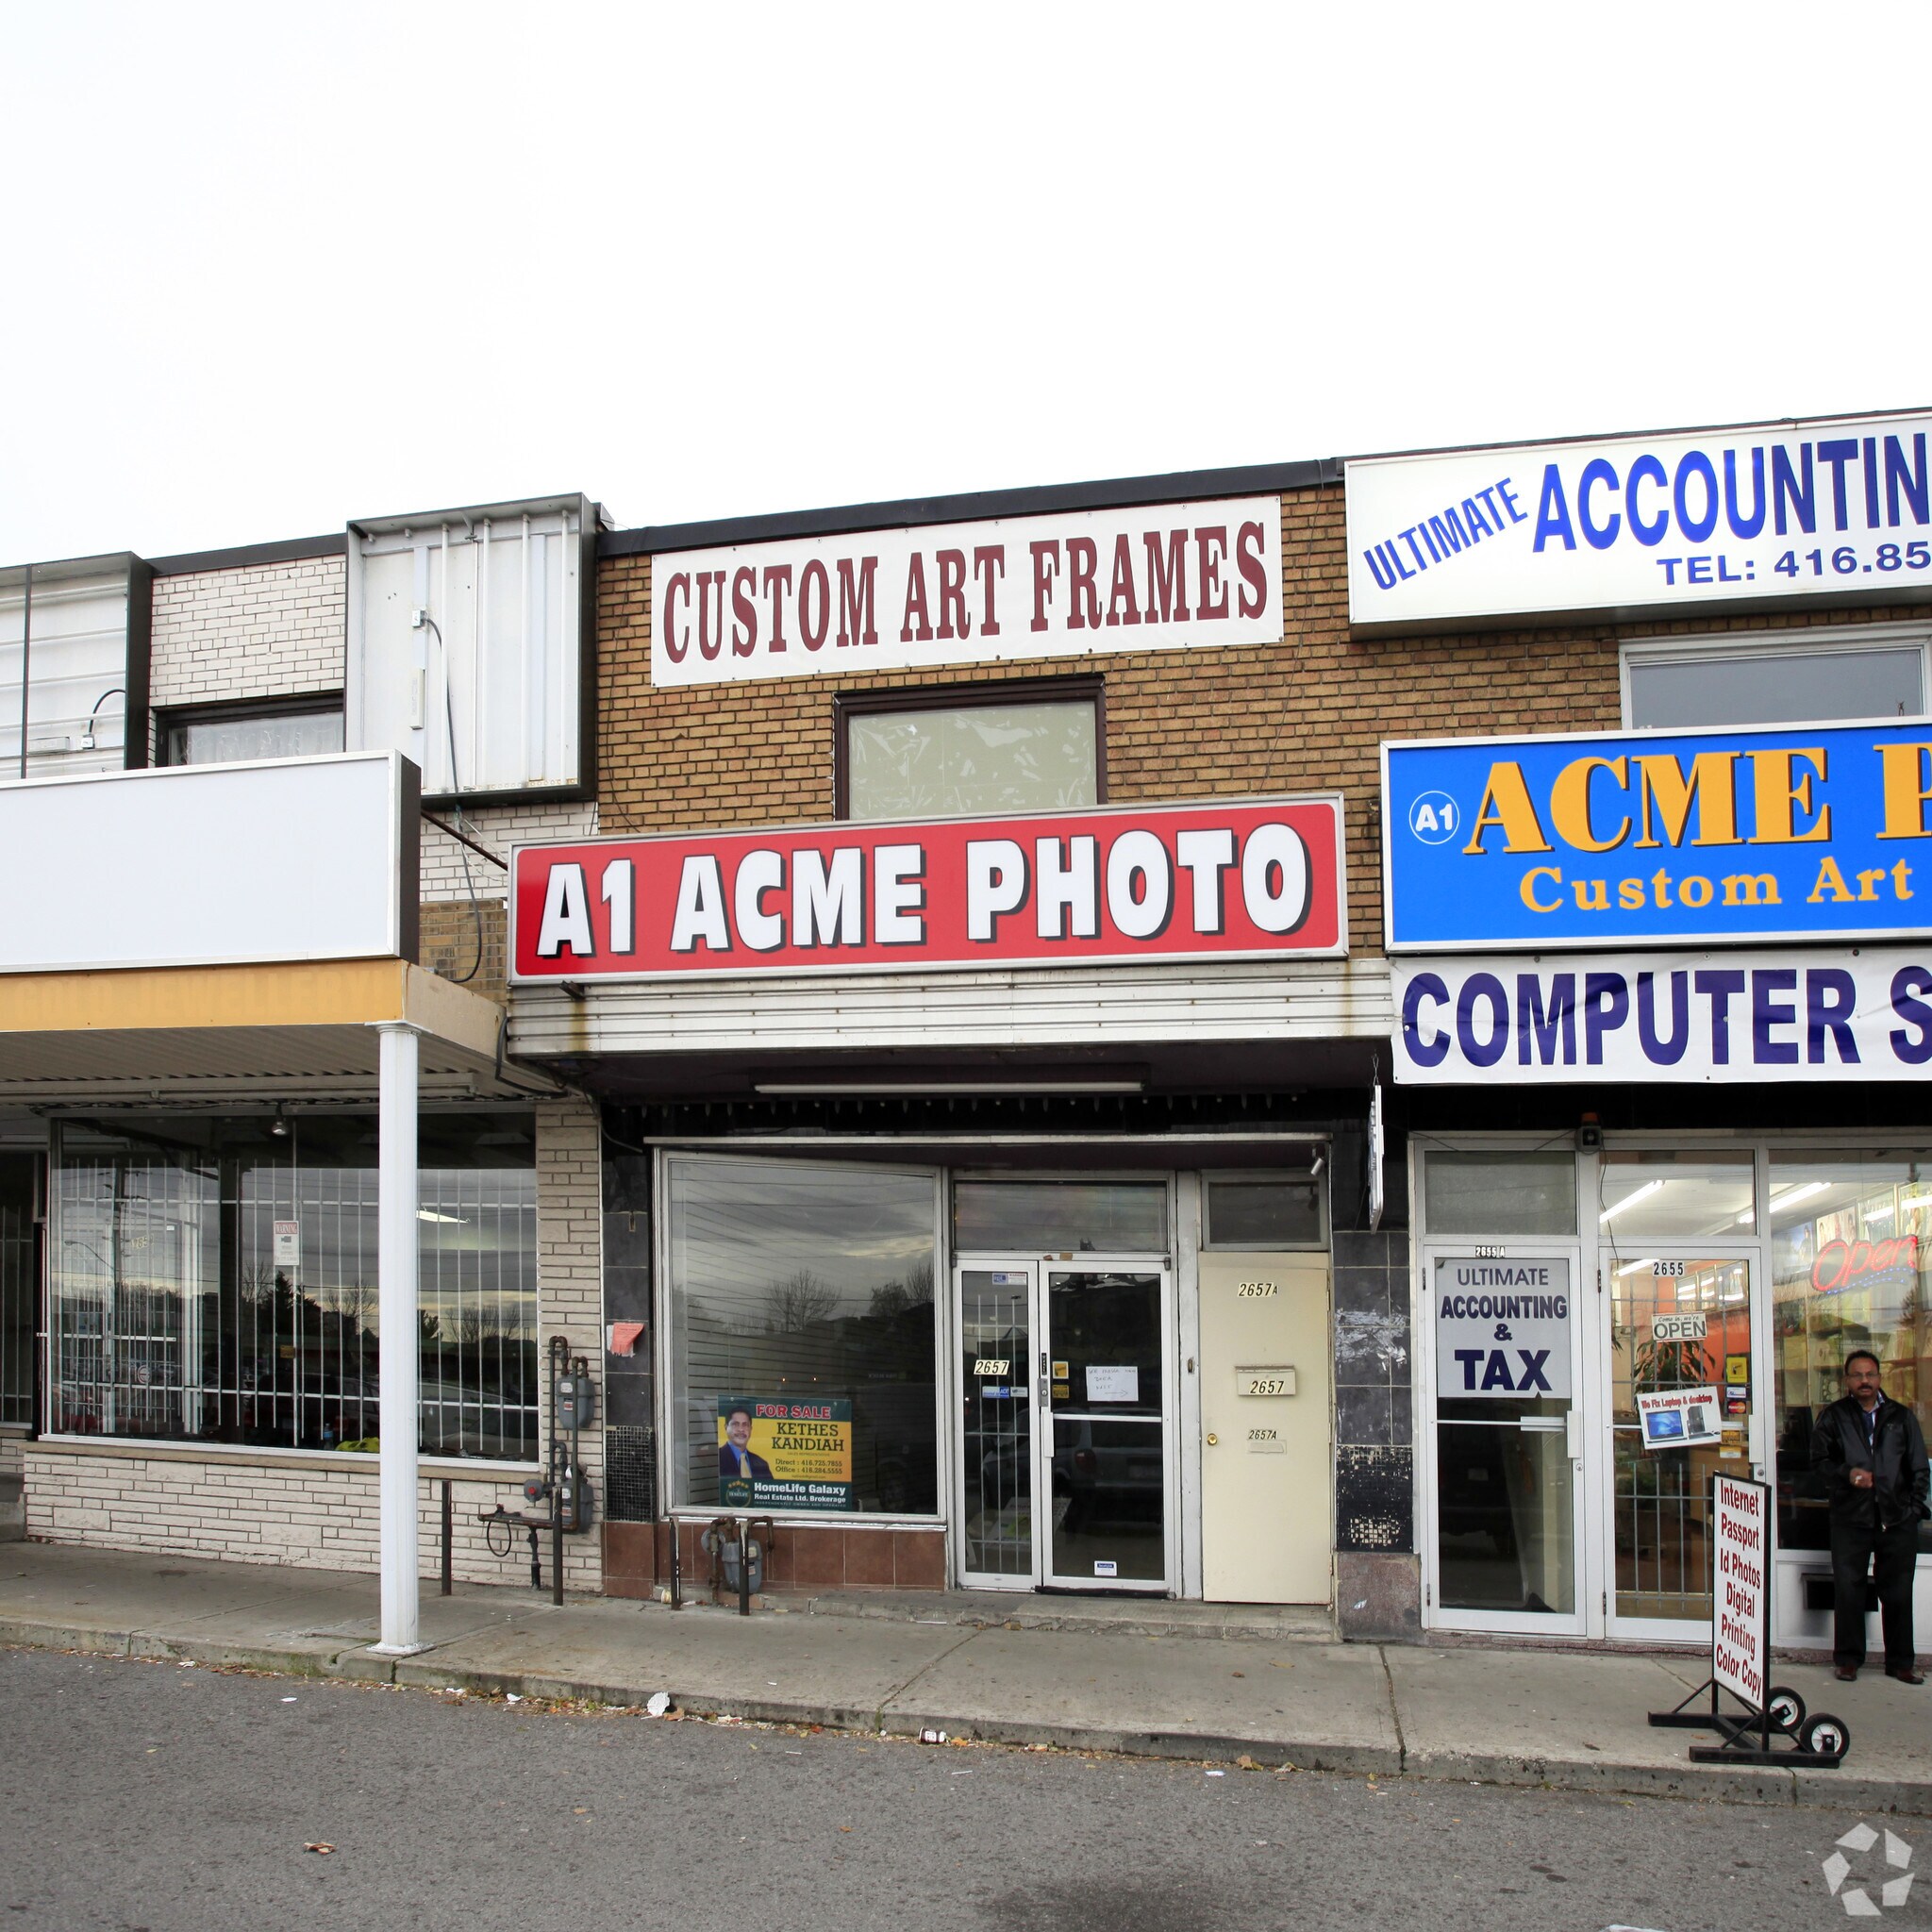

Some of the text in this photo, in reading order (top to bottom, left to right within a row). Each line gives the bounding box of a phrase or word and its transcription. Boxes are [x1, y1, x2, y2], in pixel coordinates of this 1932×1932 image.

[1363, 432, 1930, 591] ULTIMATE ACCOUNTIN
[1657, 541, 1931, 586] TEL: 416.85
[663, 521, 1267, 663] CUSTOM ART FRAMES
[1462, 747, 1832, 855] ACME
[1416, 802, 1454, 832] A1
[536, 823, 1313, 958] A1 ACME PHOTO
[1520, 856, 1915, 912] Custom Art
[1402, 966, 1932, 1068] COMPUTER S
[1476, 1246, 1497, 1257] 2655
[1812, 1234, 1918, 1291] Open
[1457, 1268, 1549, 1286] ULTIMATE
[1654, 1262, 1684, 1275] 2655
[1238, 1283, 1278, 1297] 2657A
[1441, 1295, 1568, 1319] ACCOUNTING
[1493, 1323, 1513, 1341] &
[1654, 1321, 1706, 1339] OPEN
[975, 1360, 1008, 1374] 2657
[1454, 1349, 1553, 1391] TAX
[1250, 1380, 1284, 1394] 2657
[756, 1404, 831, 1419] FOR SALE
[1651, 1399, 1661, 1407] Fix
[1661, 1397, 1681, 1408] Laptop
[1683, 1395, 1688, 1405] &
[1689, 1394, 1713, 1406] desktop
[776, 1422, 839, 1437] KETHES
[1248, 1429, 1277, 1440] 2657A
[772, 1437, 844, 1452] KANDIAH
[755, 1482, 846, 1496] HomeLife Galaxy
[809, 1495, 846, 1504] Brokerage
[1720, 1479, 1759, 1517] Internet
[1721, 1512, 1759, 1552] Passport
[1720, 1547, 1761, 1591] Id Photos
[1726, 1581, 1756, 1619] Digital
[1721, 1613, 1756, 1662] Printing
[1716, 1643, 1762, 1701] Color Copy
